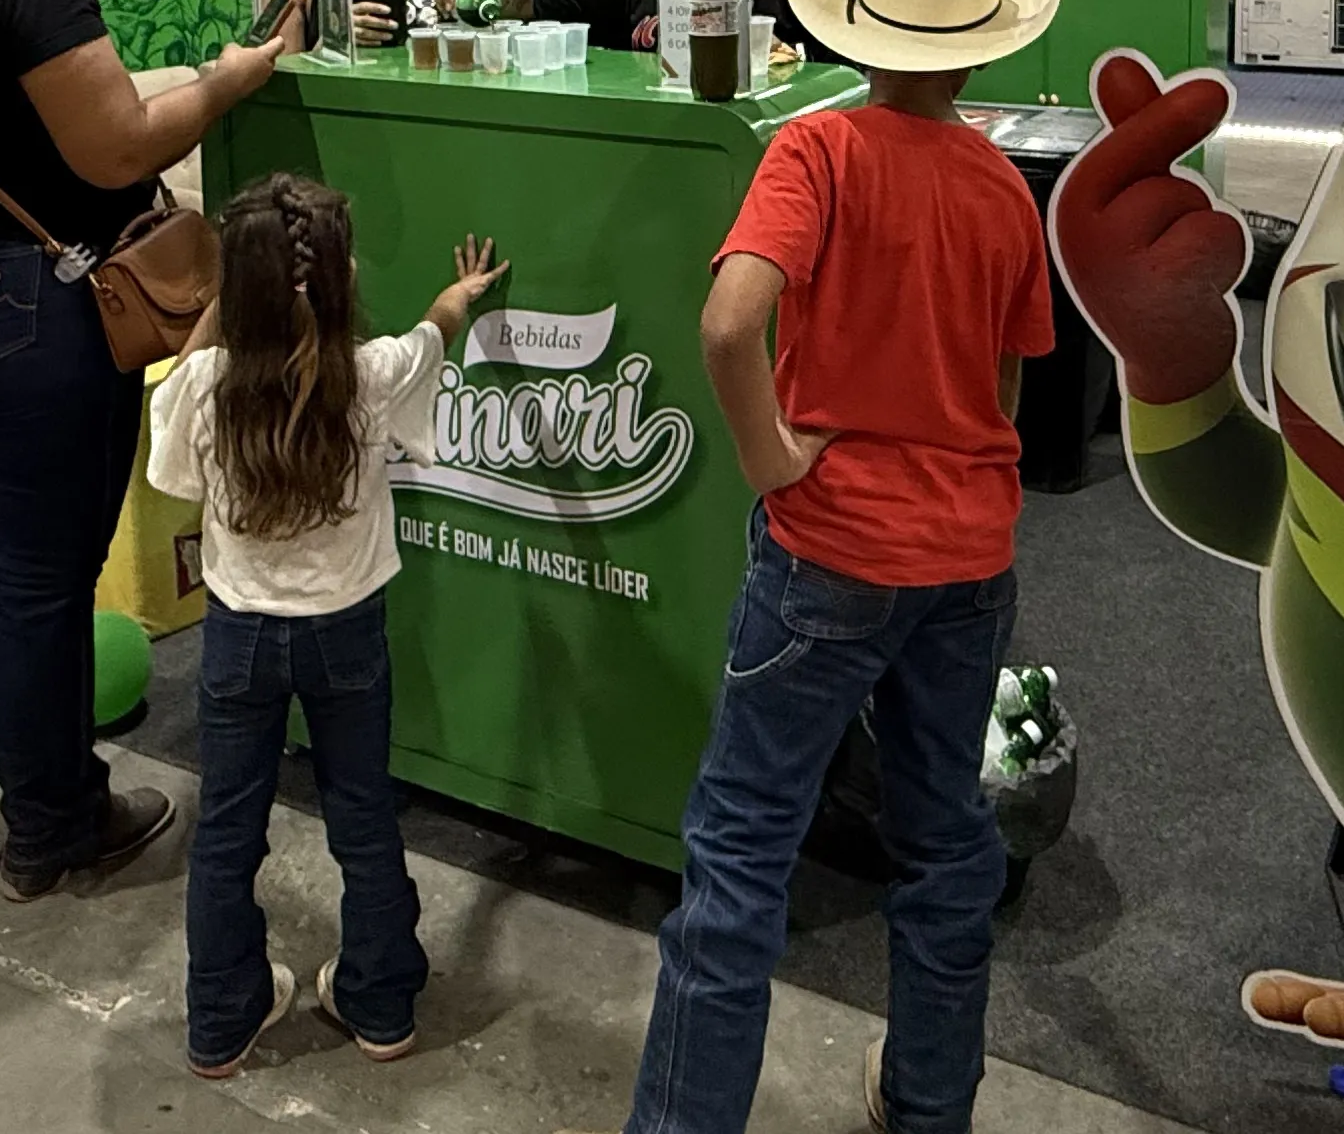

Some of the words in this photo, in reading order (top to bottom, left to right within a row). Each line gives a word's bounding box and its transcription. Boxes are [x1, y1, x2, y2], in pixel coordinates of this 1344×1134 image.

[498, 323, 582, 350] Bebidas
[399, 516, 435, 549] QUE
[438, 520, 450, 552] É
[453, 528, 493, 563] BOM
[497, 538, 522, 570] JÁ
[526, 546, 589, 587] NASCE
[593, 560, 649, 602] LÍDER
